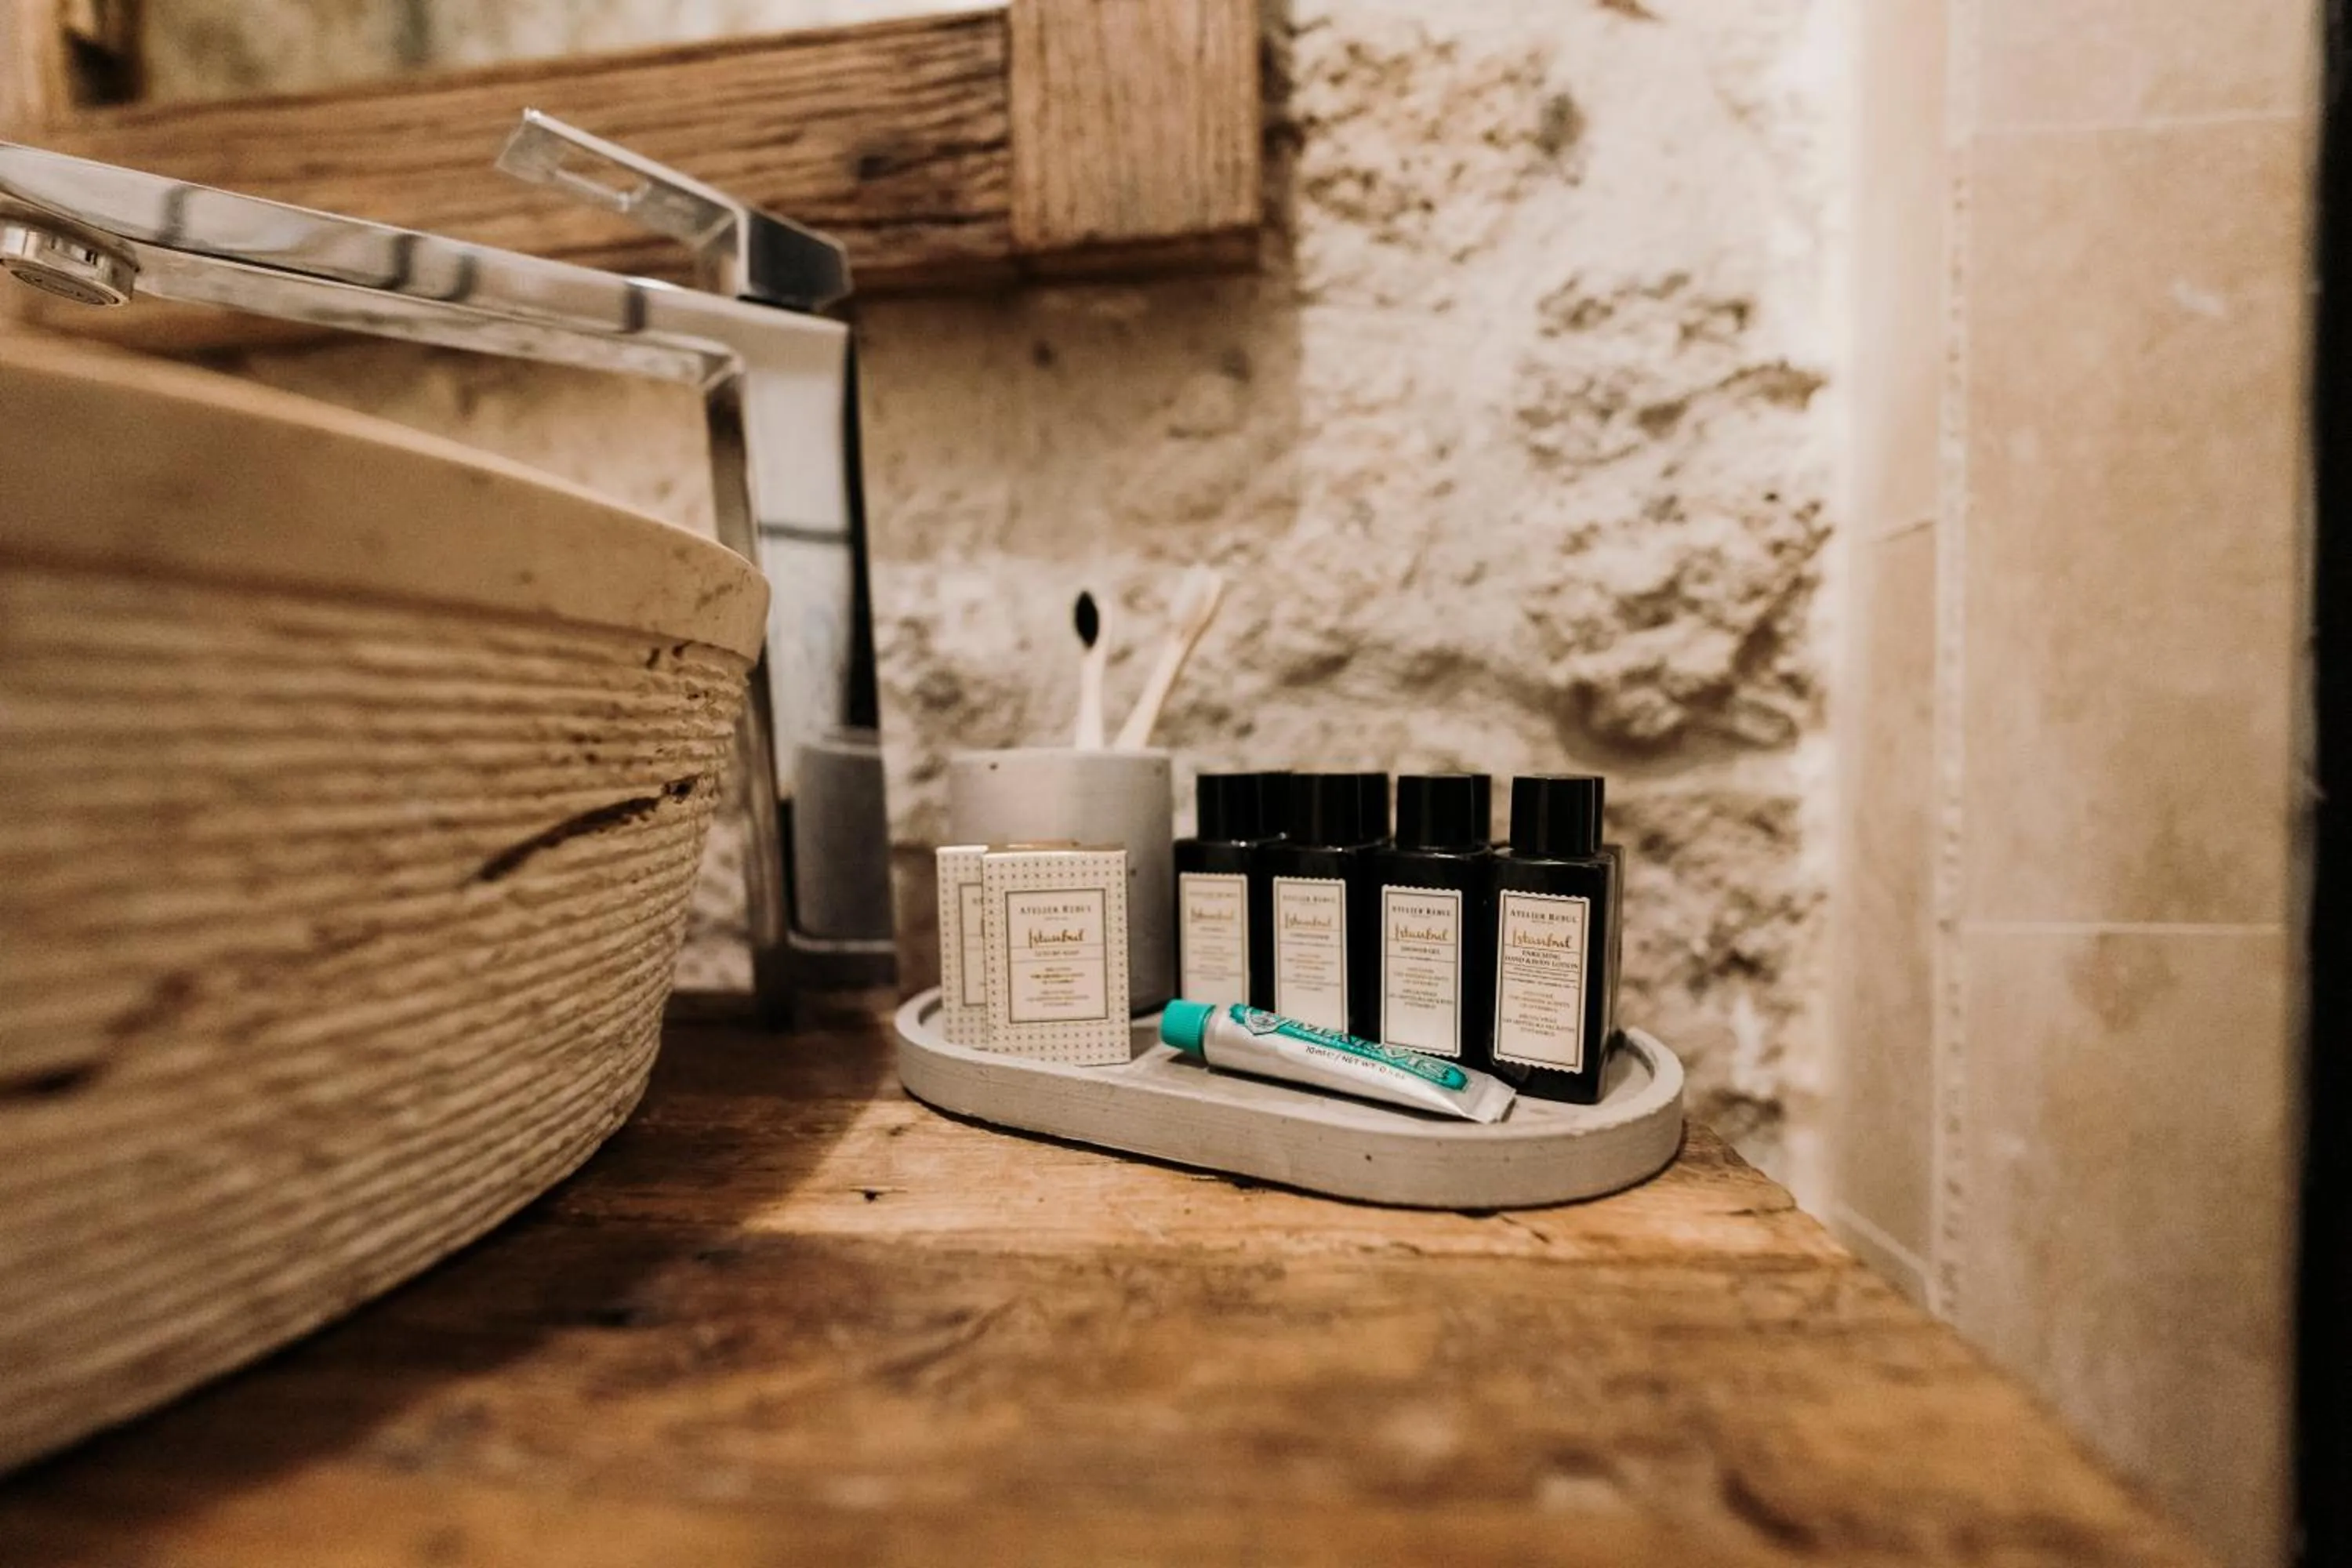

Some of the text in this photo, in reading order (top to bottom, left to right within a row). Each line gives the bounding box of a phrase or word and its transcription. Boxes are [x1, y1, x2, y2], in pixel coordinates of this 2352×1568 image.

[1510, 909, 1545, 920] ATELIER
[1548, 913, 1577, 924] REBUL
[1028, 927, 1085, 949] Istanbul
[1395, 922, 1449, 942] Istanbul
[1512, 927, 1573, 949] Istanbul
